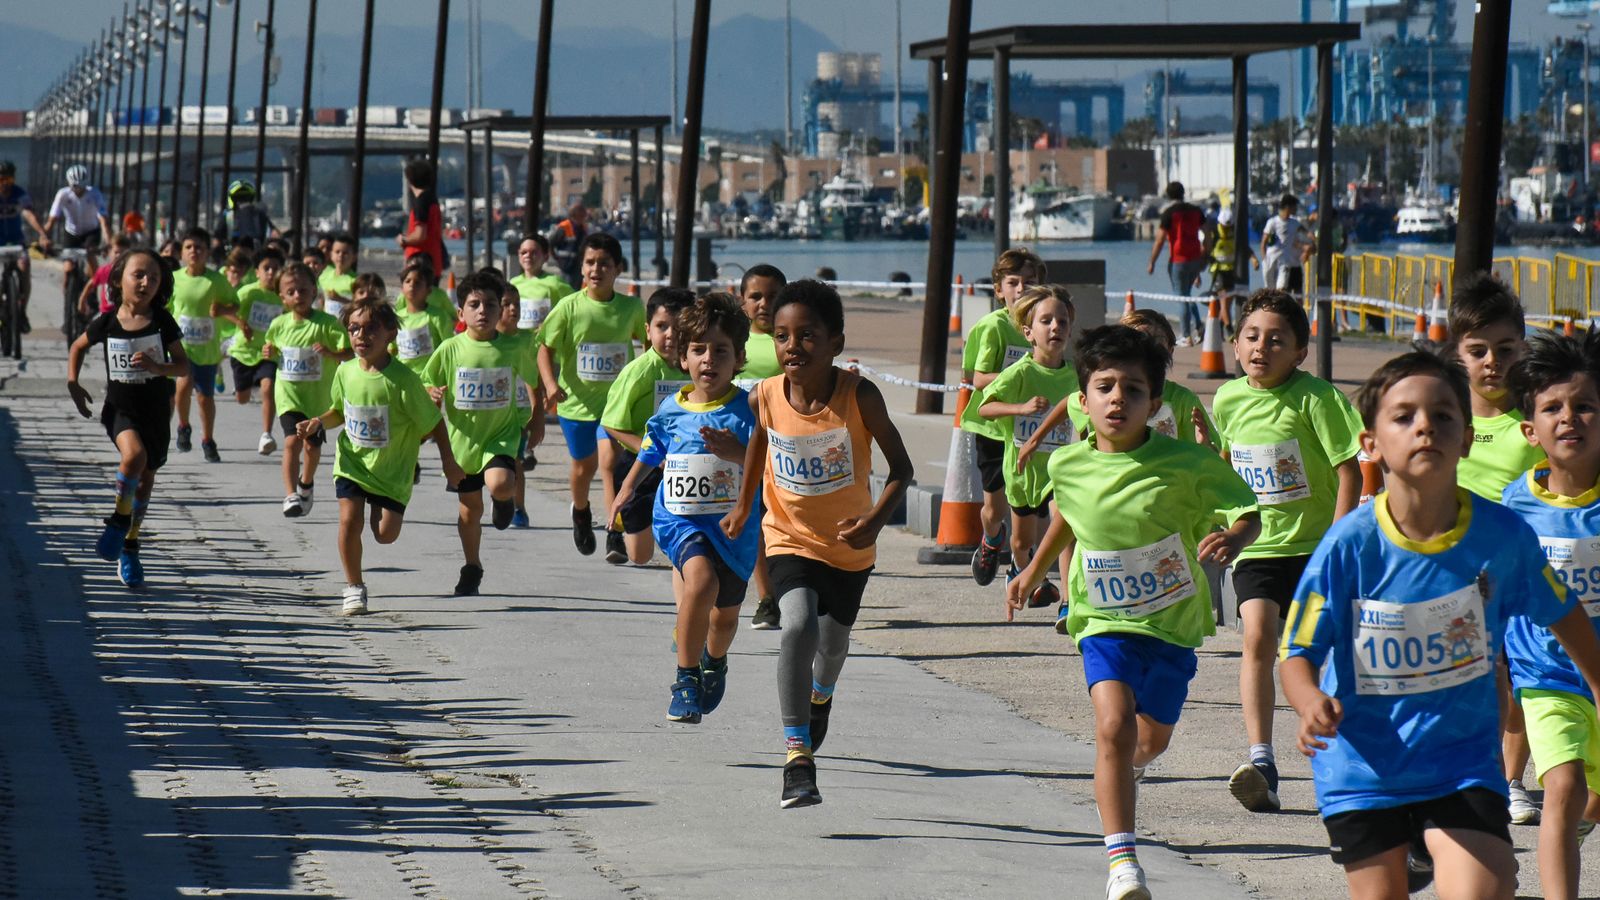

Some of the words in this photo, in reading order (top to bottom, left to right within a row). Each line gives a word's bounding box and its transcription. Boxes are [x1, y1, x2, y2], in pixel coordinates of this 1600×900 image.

[581, 356, 613, 371] 1105
[460, 383, 494, 398] 1213
[776, 452, 823, 479] 1048
[667, 476, 710, 498] 1526
[1087, 557, 1104, 569] XXI
[1094, 571, 1157, 602] 1039
[1359, 608, 1379, 624] XXI
[1363, 632, 1446, 669] 1005
